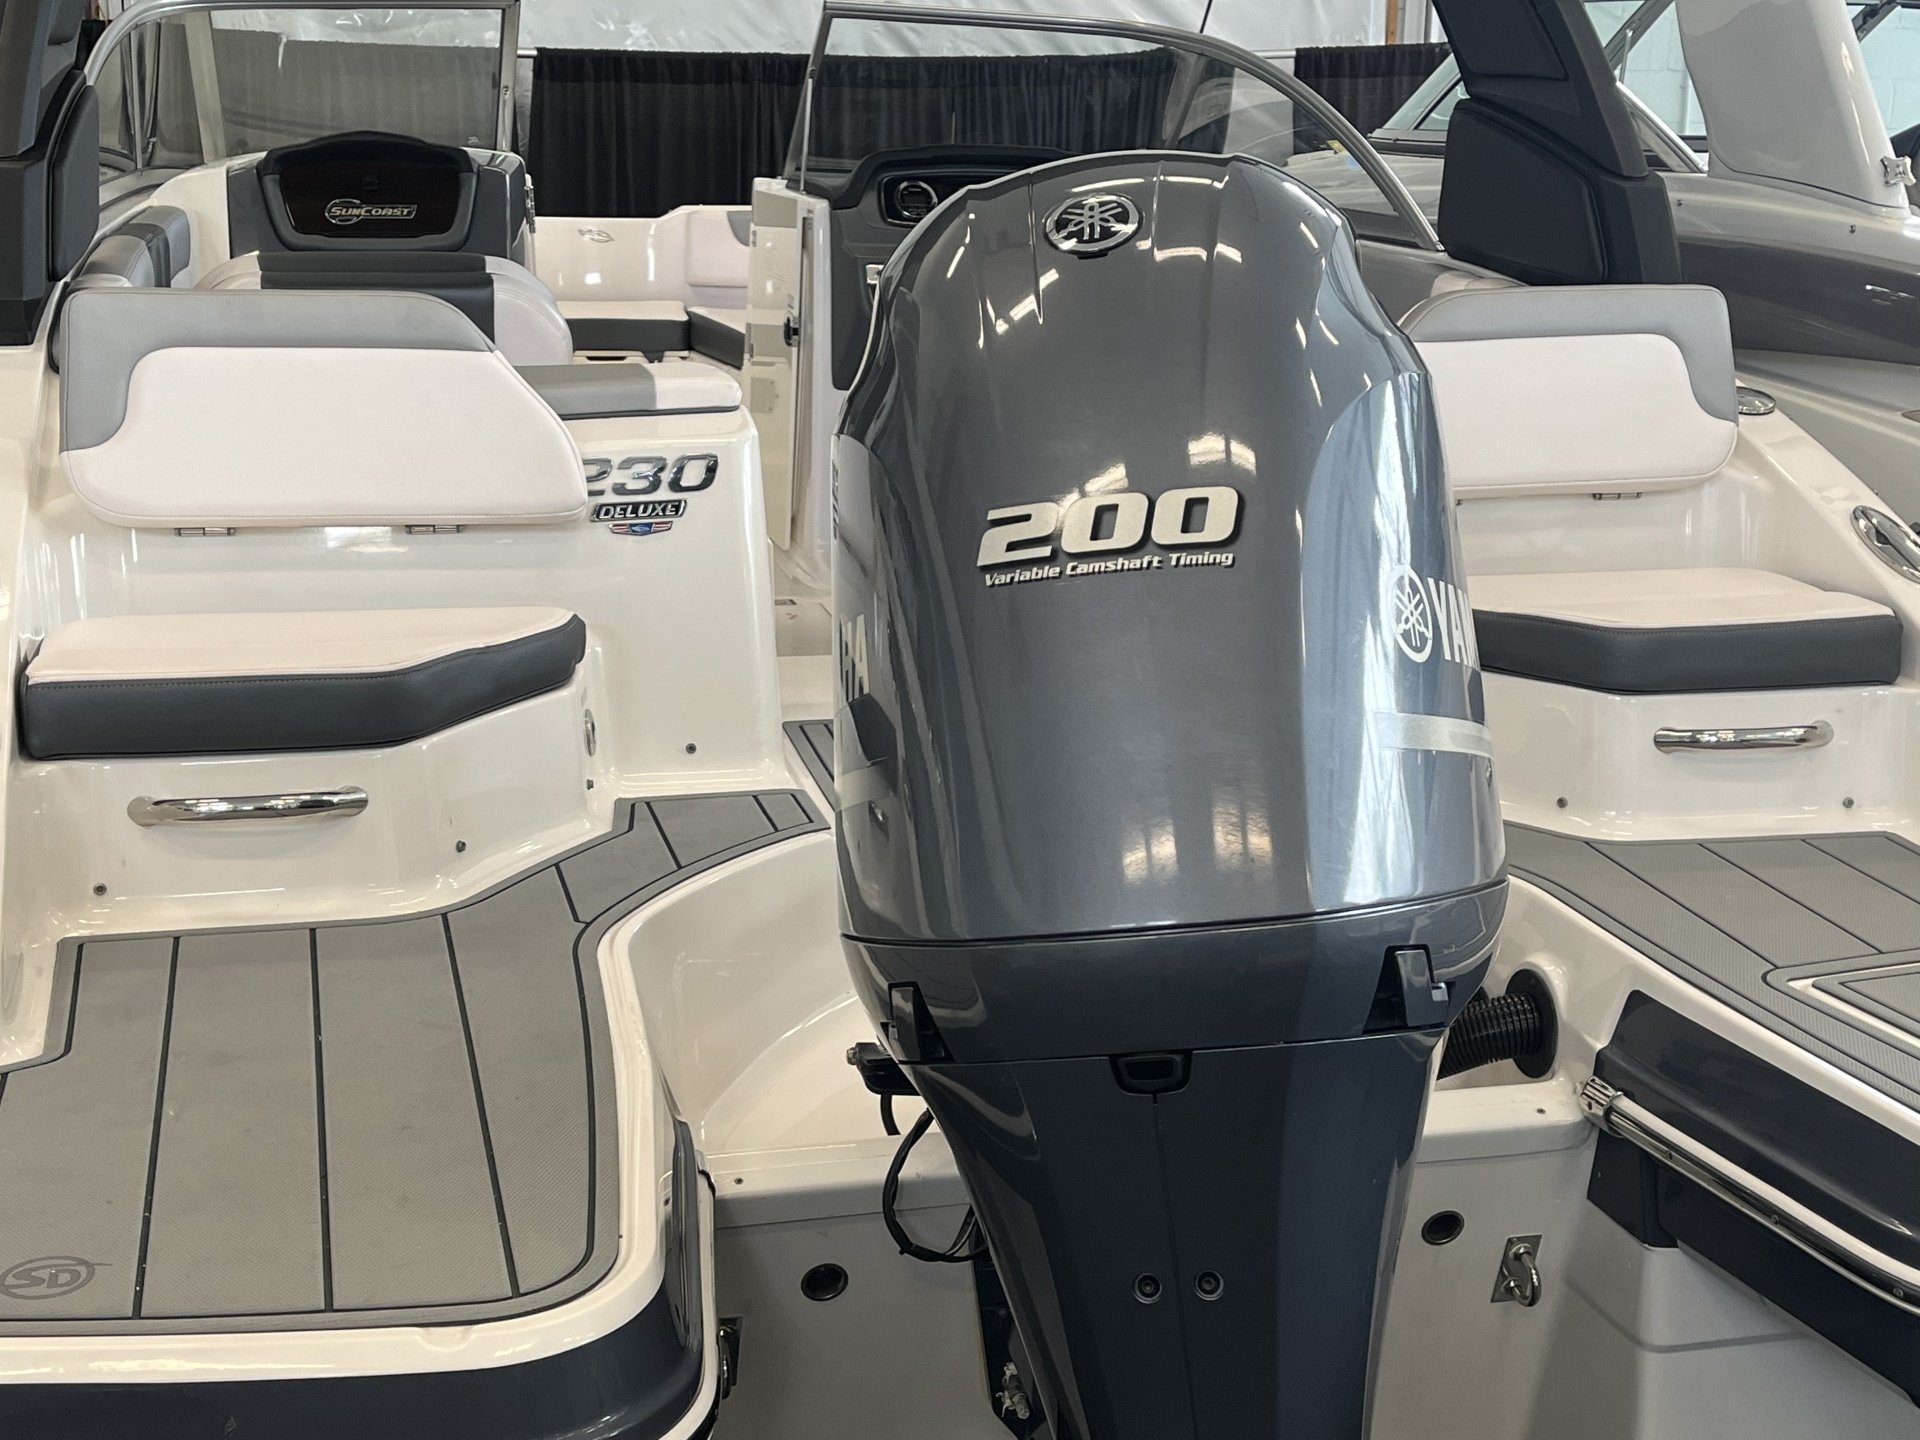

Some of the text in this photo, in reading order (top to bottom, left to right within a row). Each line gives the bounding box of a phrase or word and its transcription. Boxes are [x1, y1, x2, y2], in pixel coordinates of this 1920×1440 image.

[581, 453, 719, 496] 230
[598, 502, 679, 519] DELUXE
[976, 486, 1240, 567] 200
[984, 552, 1234, 587] Variable Camshaft Timing
